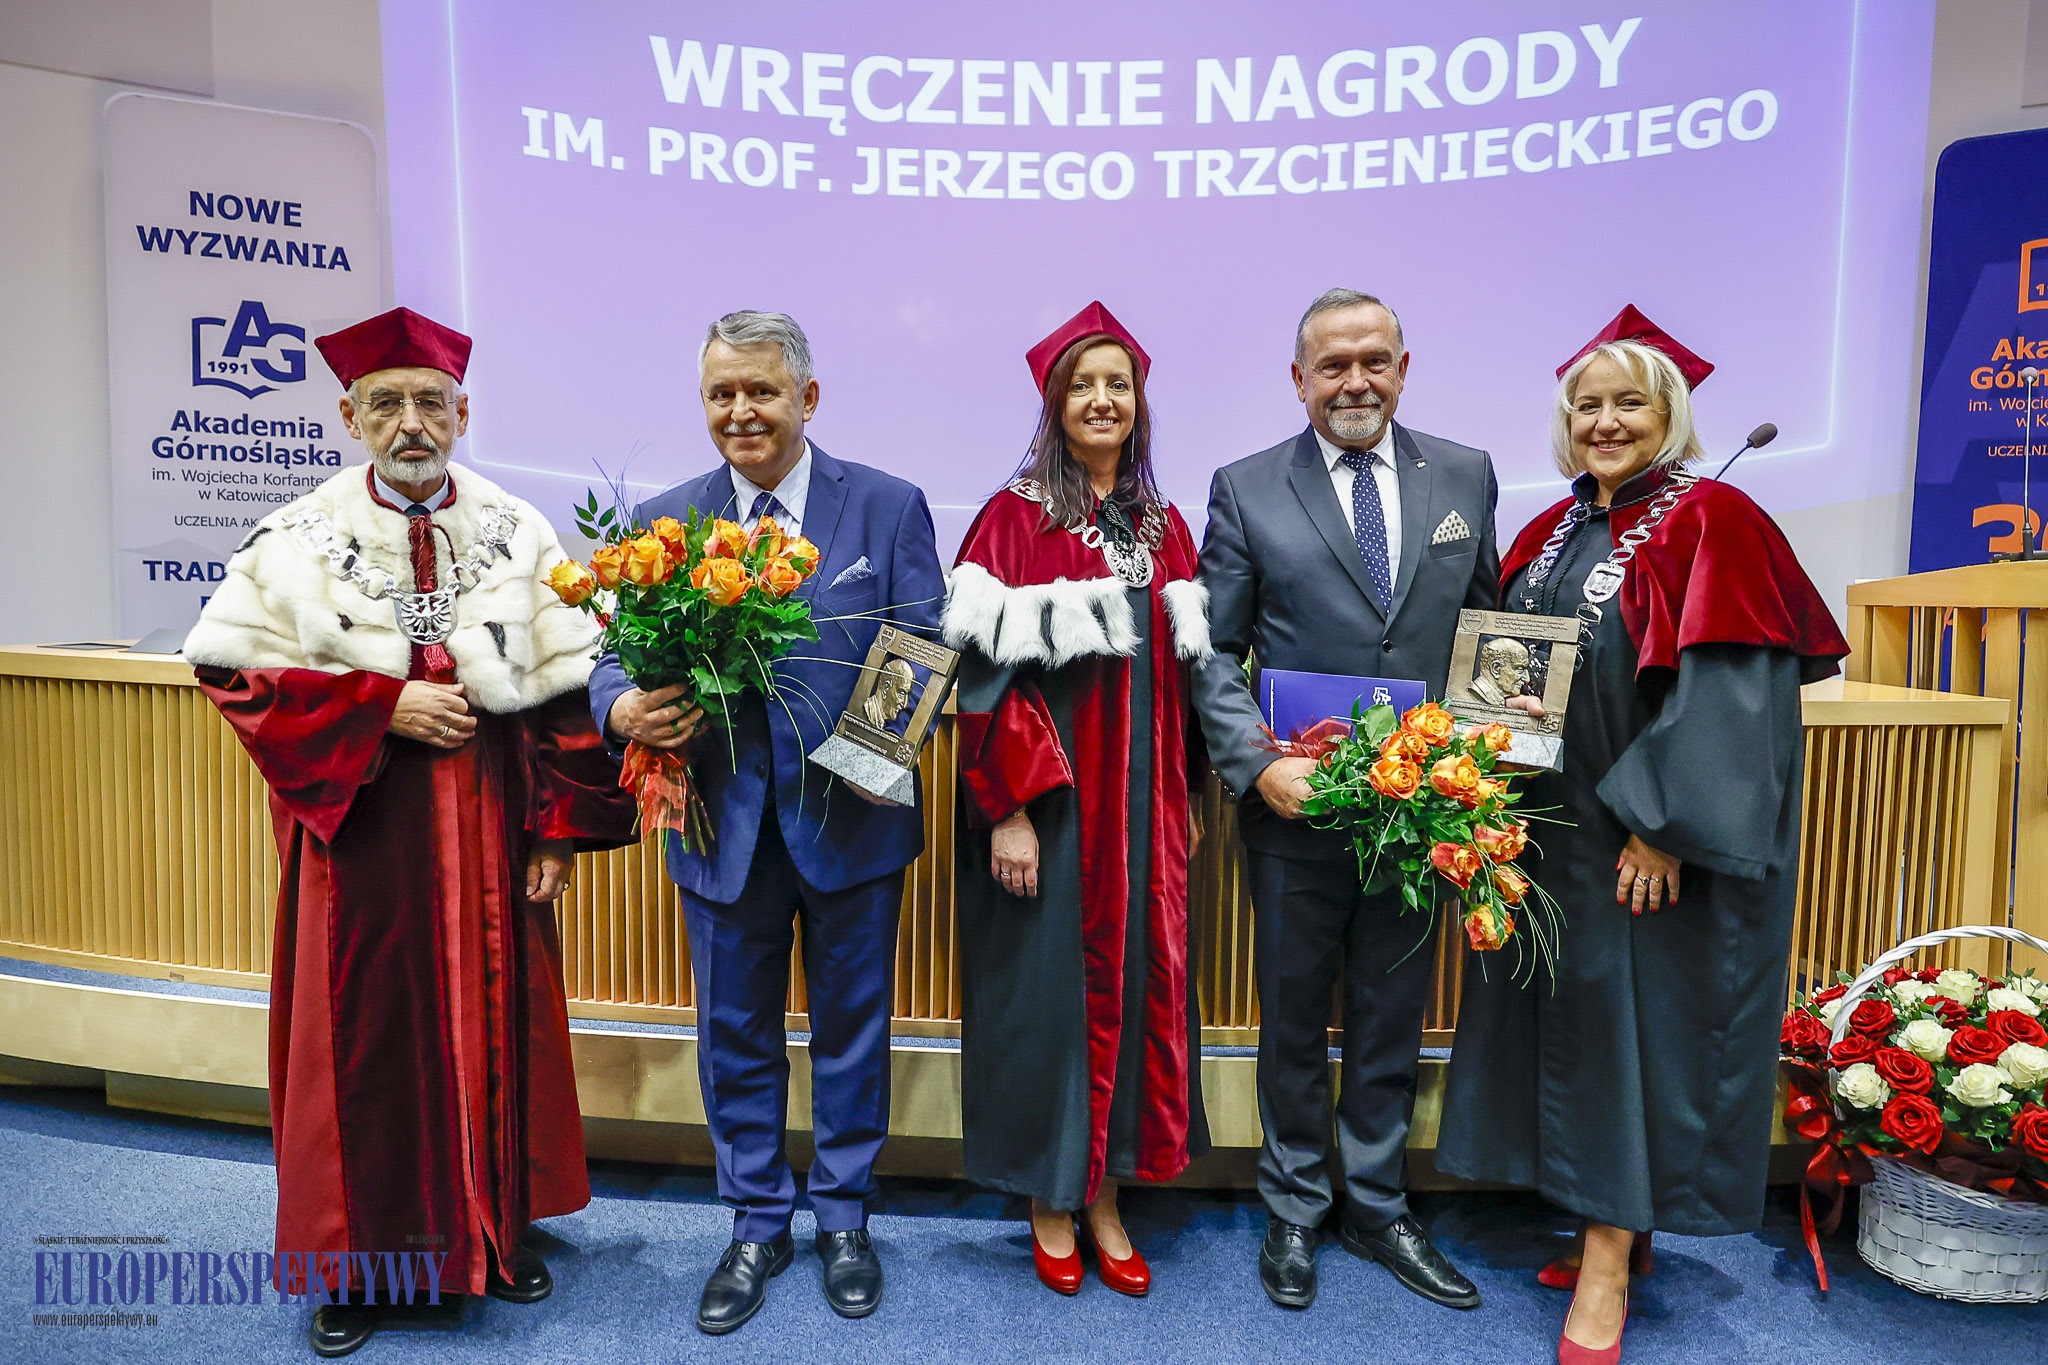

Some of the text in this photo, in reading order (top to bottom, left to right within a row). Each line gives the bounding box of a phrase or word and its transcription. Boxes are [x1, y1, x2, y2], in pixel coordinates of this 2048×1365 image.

[648, 16, 1644, 137] WRĘCZENIE NAGRODY
[520, 88, 1780, 201] IM. PROF. JERZEGO TRZCIENIECKIEGO
[189, 190, 302, 228] NOWE
[136, 224, 352, 272] WYZWANIA
[222, 299, 306, 383] AG
[207, 360, 248, 375] 1991
[1969, 398, 1993, 412] im.
[170, 409, 324, 440] Akademia
[151, 435, 342, 469] Górnośląska
[1988, 444, 2048, 457] UCZENI
[152, 467, 329, 488] im. Wojciecha Korfante
[198, 487, 298, 504] w Katowicach
[174, 515, 258, 528] UCZELNIA AK
[142, 560, 228, 582] TRAD
